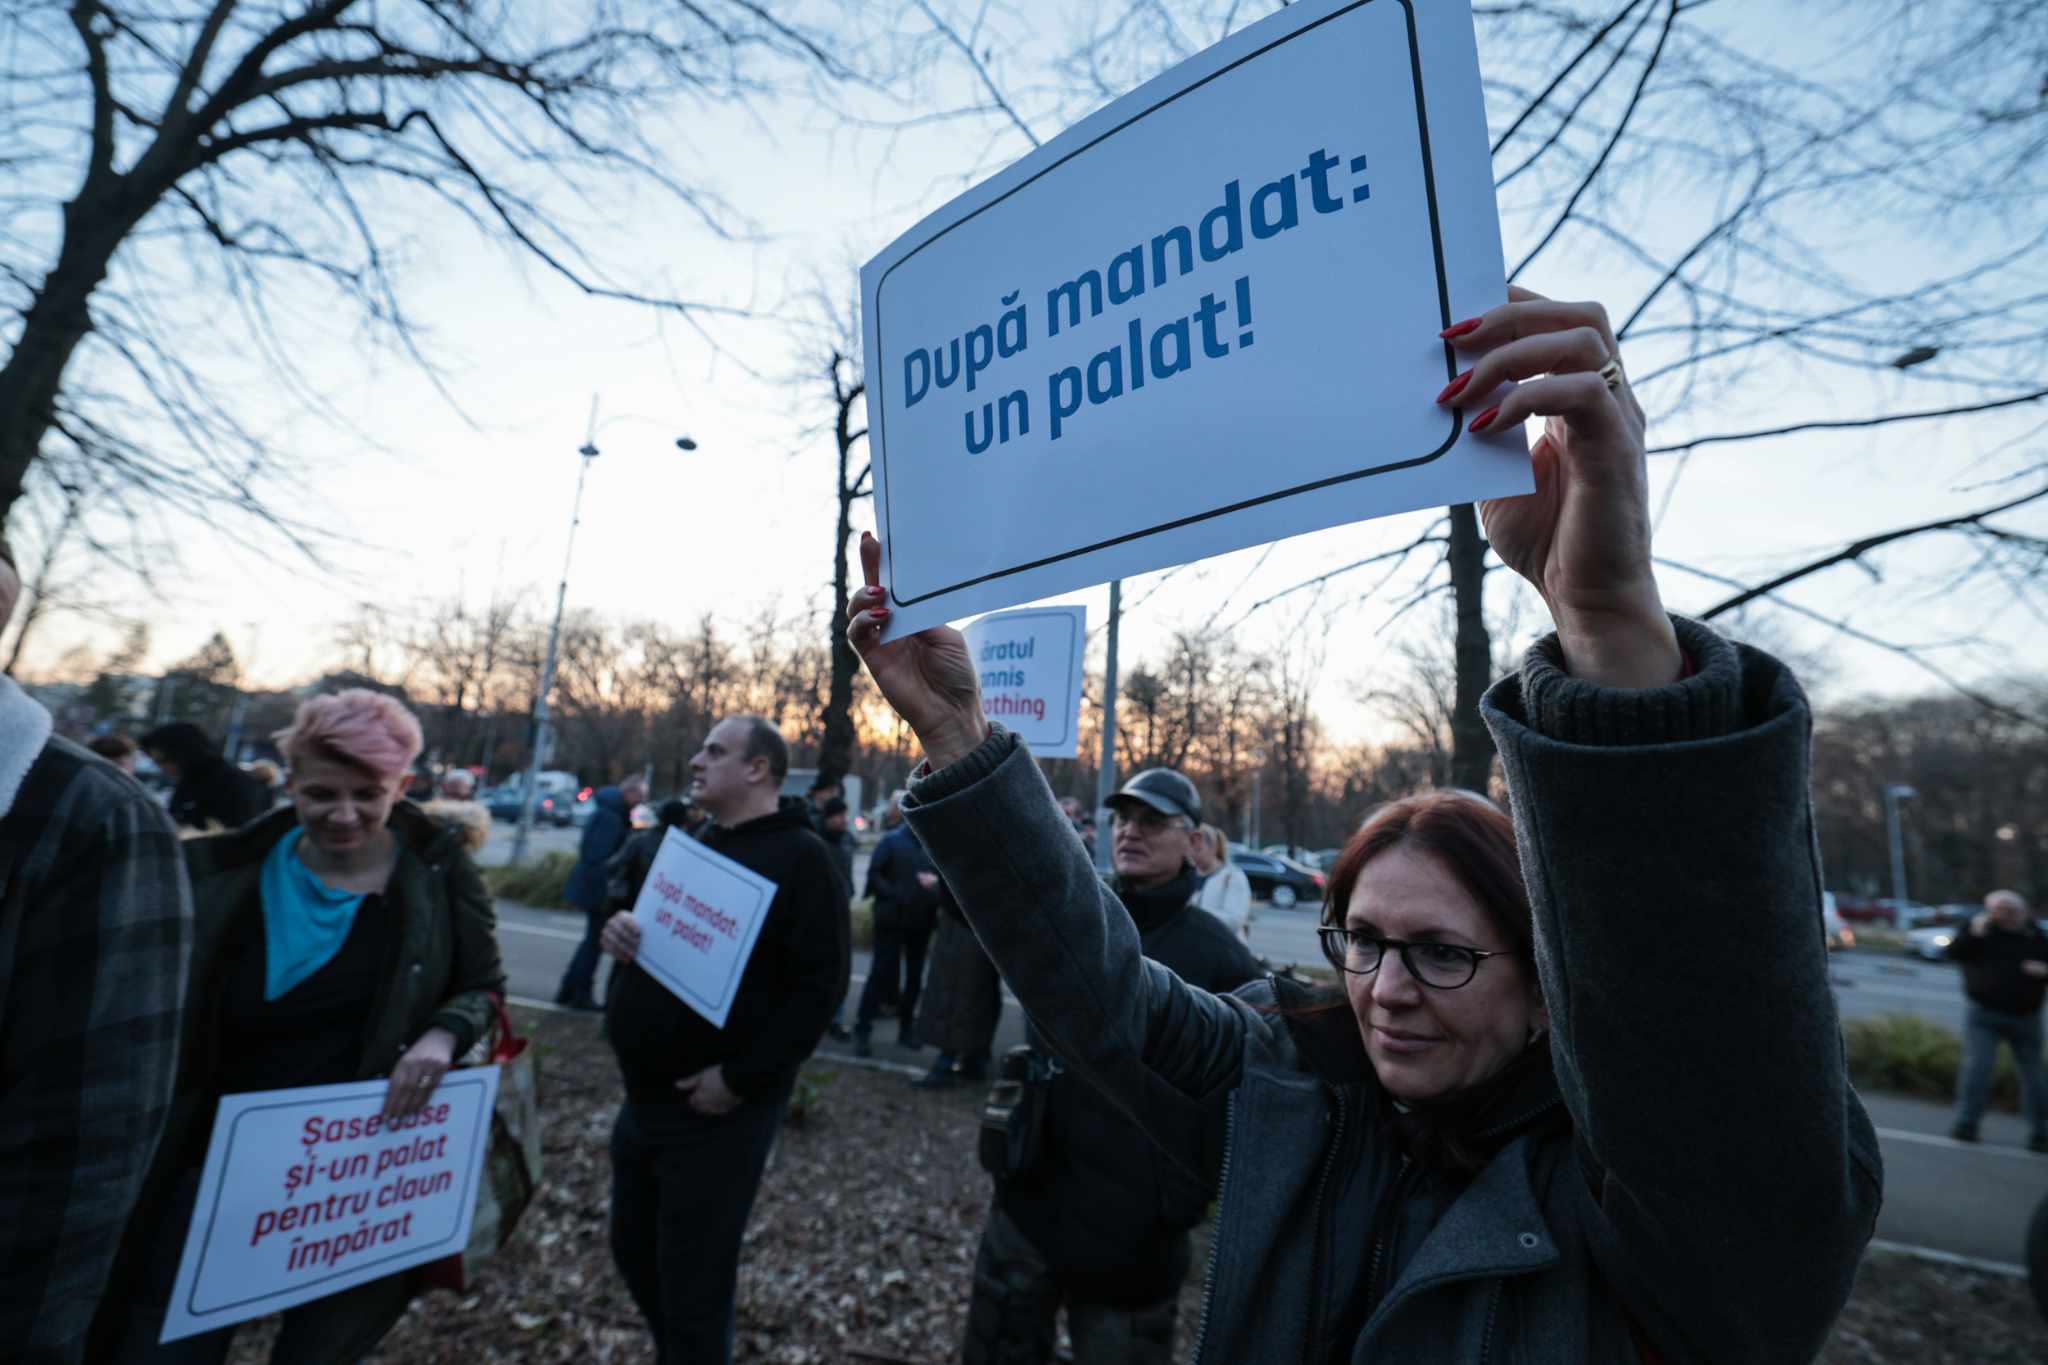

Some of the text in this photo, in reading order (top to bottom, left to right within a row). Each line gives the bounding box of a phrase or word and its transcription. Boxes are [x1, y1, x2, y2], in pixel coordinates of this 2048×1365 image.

[904, 147, 1371, 408] După mandat:
[964, 275, 1255, 455] un palat!
[655, 908, 713, 953] un palat!
[373, 1135, 449, 1180] palat
[250, 1169, 453, 1247] pentru claun
[287, 1213, 412, 1272] împărat
